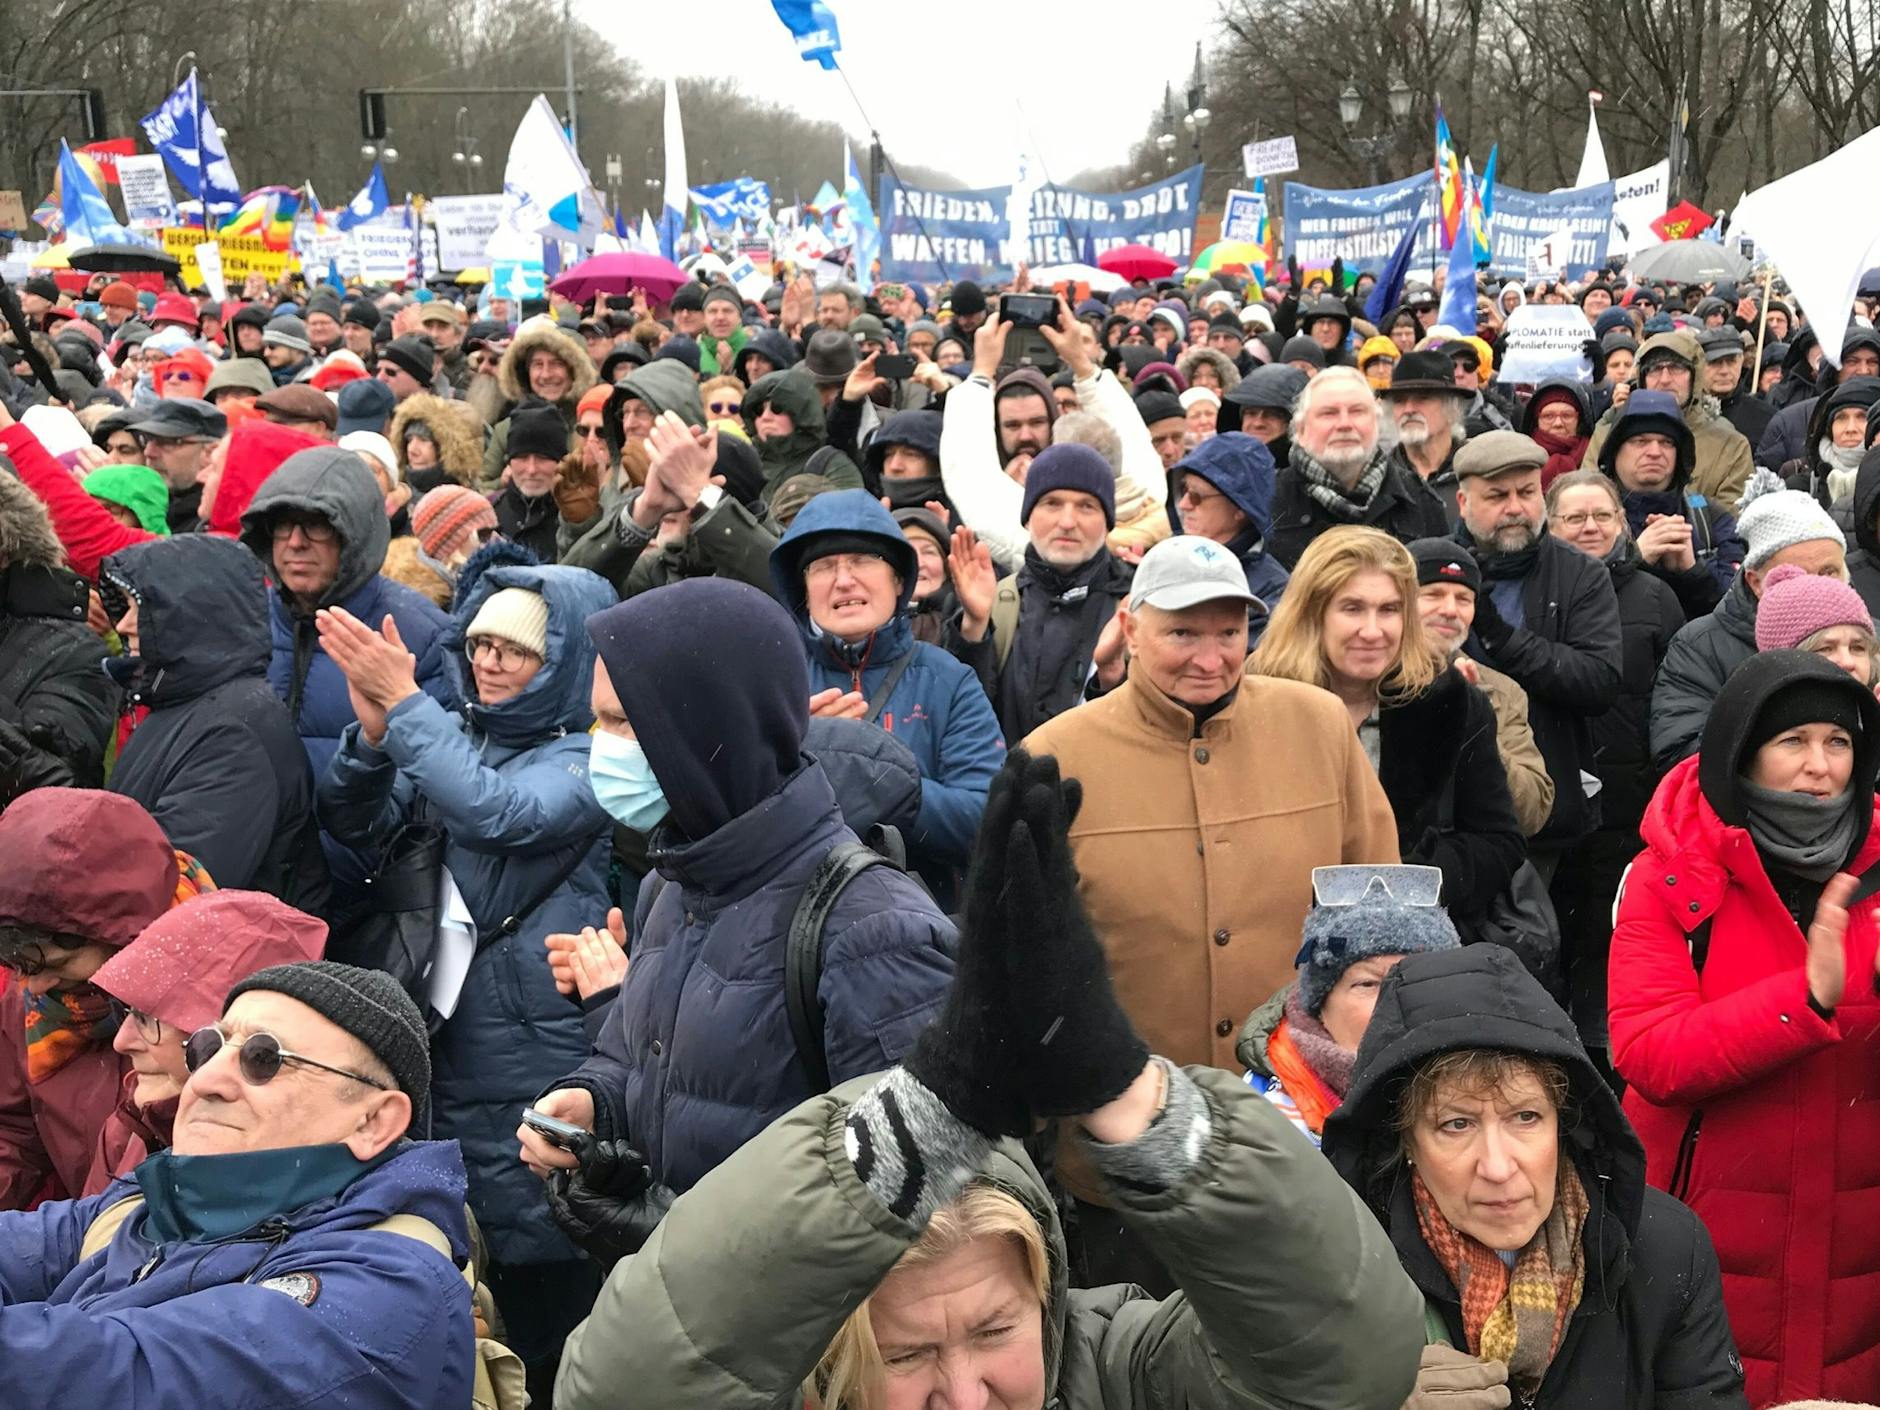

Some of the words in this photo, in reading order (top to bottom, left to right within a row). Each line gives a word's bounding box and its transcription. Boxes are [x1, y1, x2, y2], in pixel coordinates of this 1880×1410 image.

[893, 189, 1000, 224] FRIEDEN,
[1300, 218, 1329, 233] WER
[1330, 214, 1381, 232] FRIEDEN
[1570, 217, 1608, 233] SEIN!
[1567, 328, 1591, 337] statt
[1506, 341, 1586, 352] affenlieferunge
